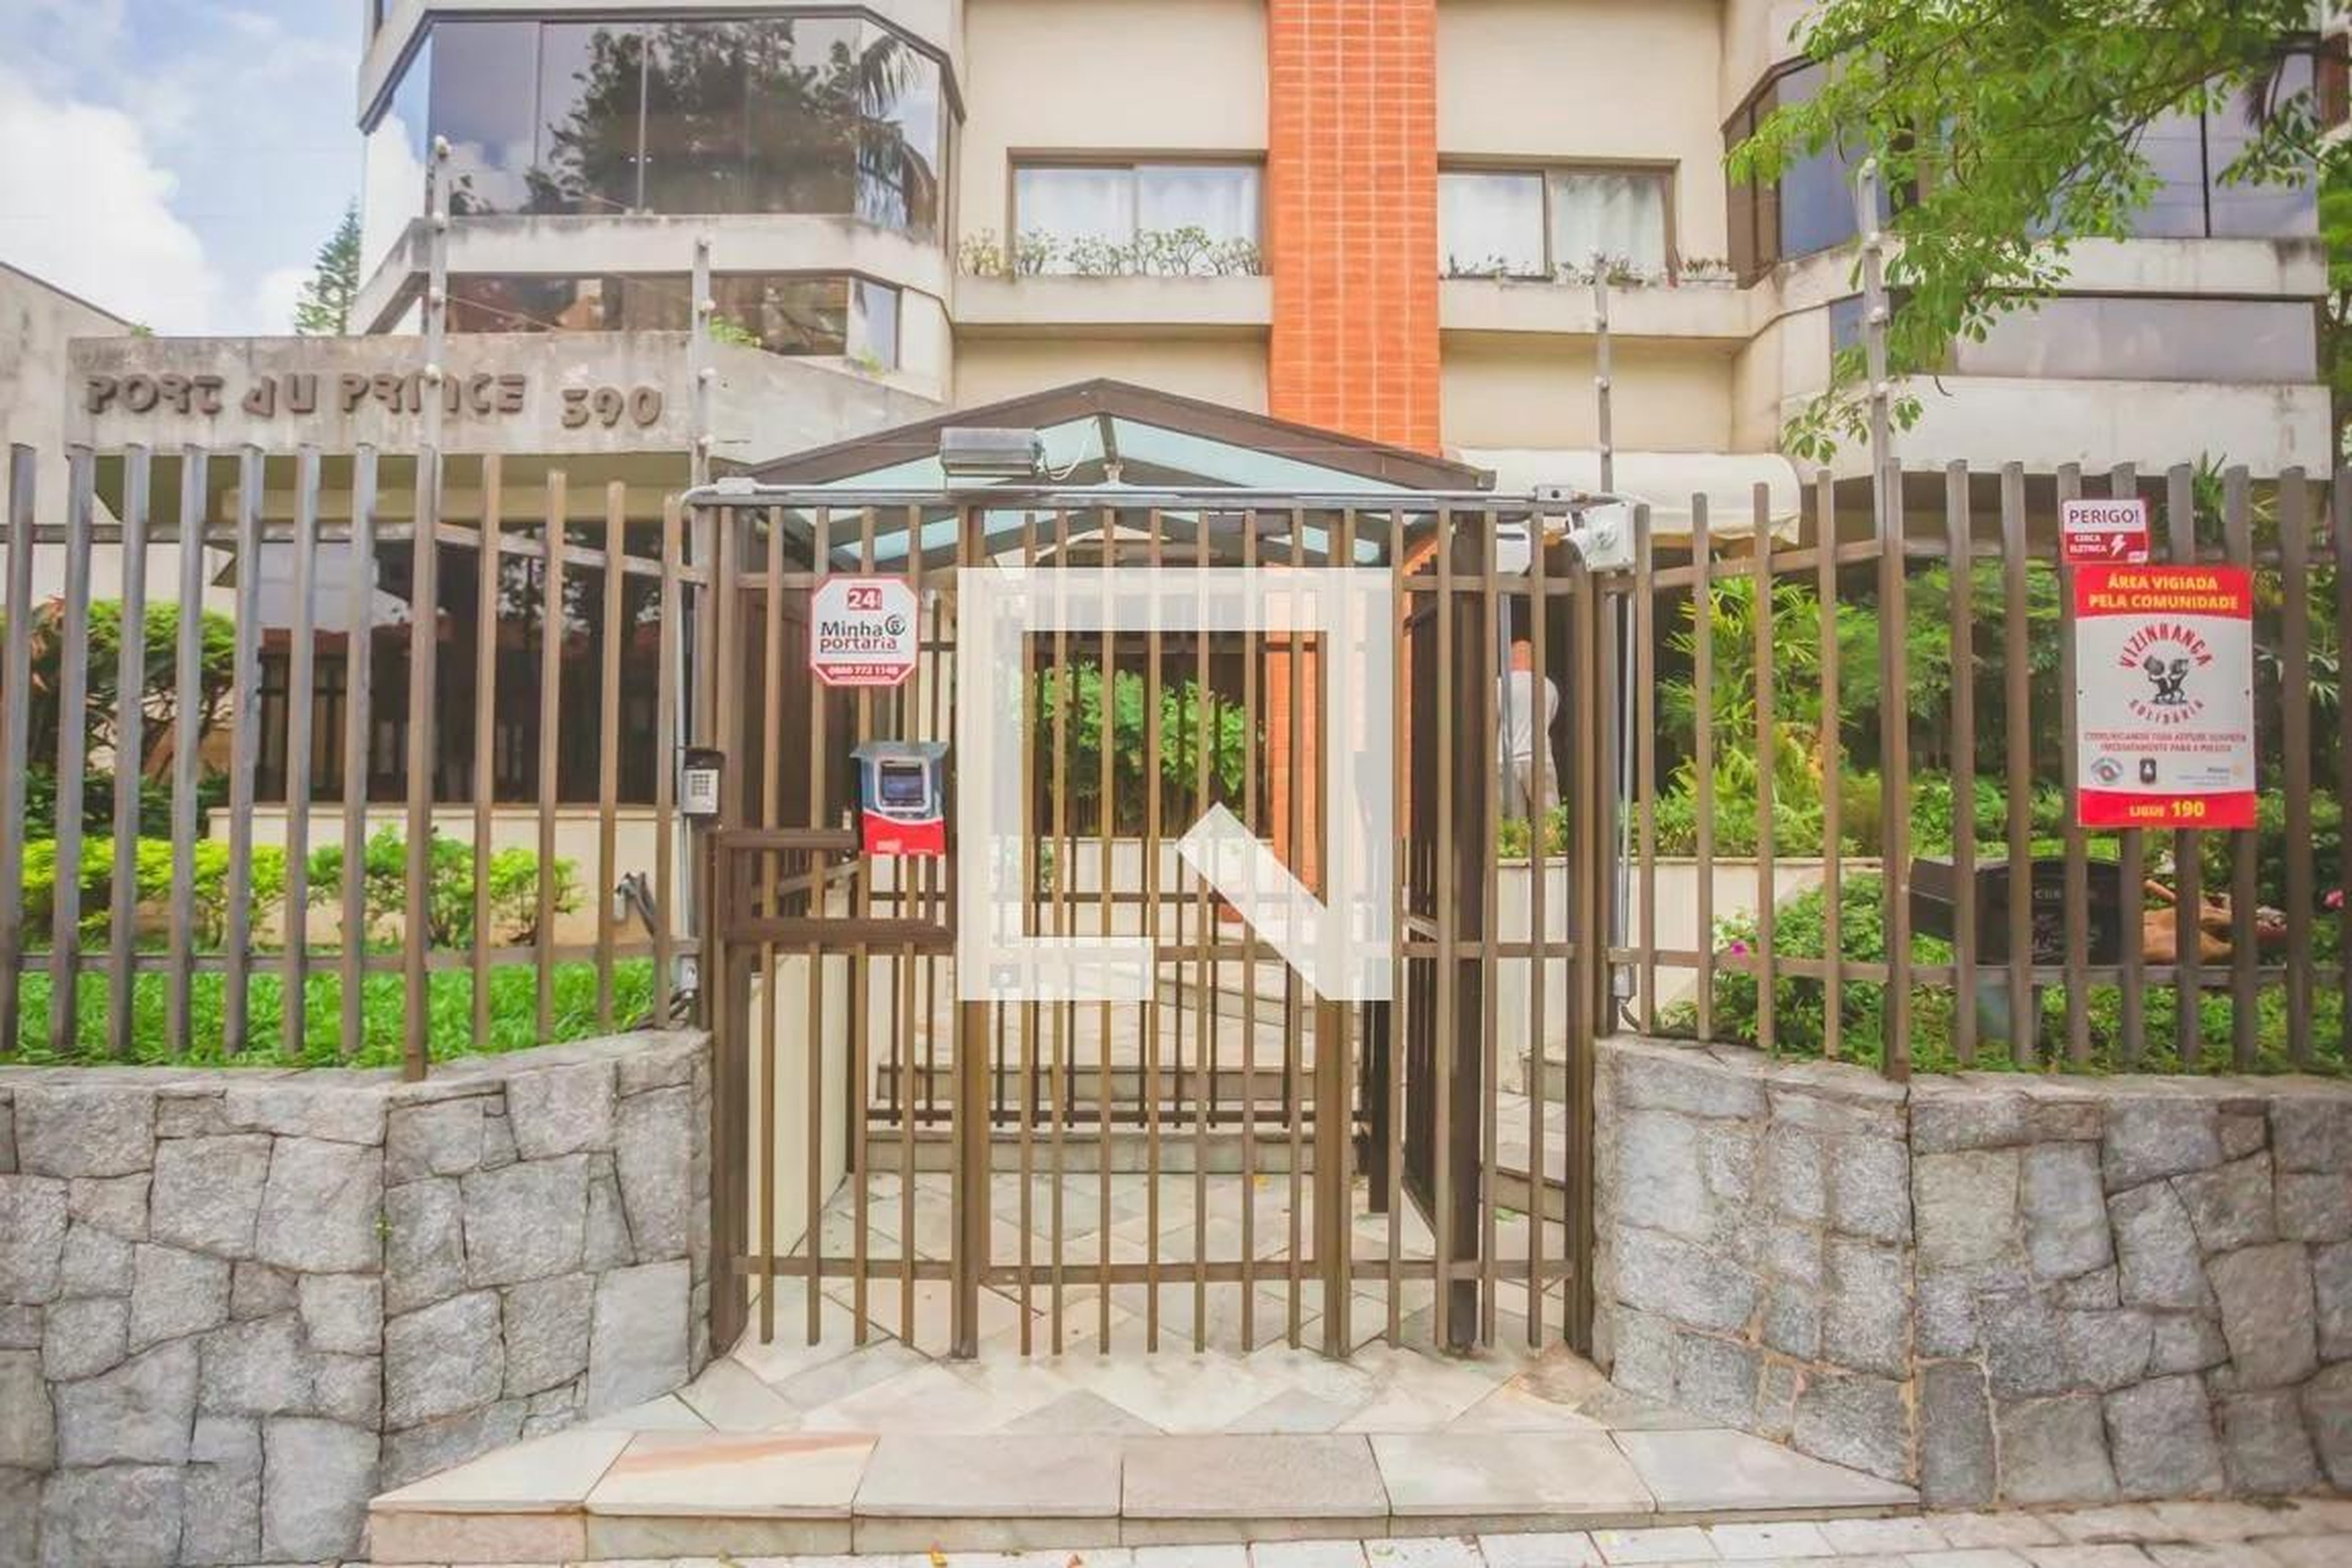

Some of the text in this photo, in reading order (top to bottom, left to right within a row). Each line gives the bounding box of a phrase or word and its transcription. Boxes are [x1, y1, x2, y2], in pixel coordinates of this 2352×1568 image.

[88, 373, 224, 415] PORT
[561, 386, 663, 429] 390
[2070, 509, 2140, 524] PERIGO!
[2108, 572, 2218, 591] ÁREA VIGIADA
[2089, 594, 2239, 610] PELA COMUNIDADE
[820, 620, 883, 637] Minha
[820, 637, 897, 654] portaria
[2172, 800, 2205, 818] 190
